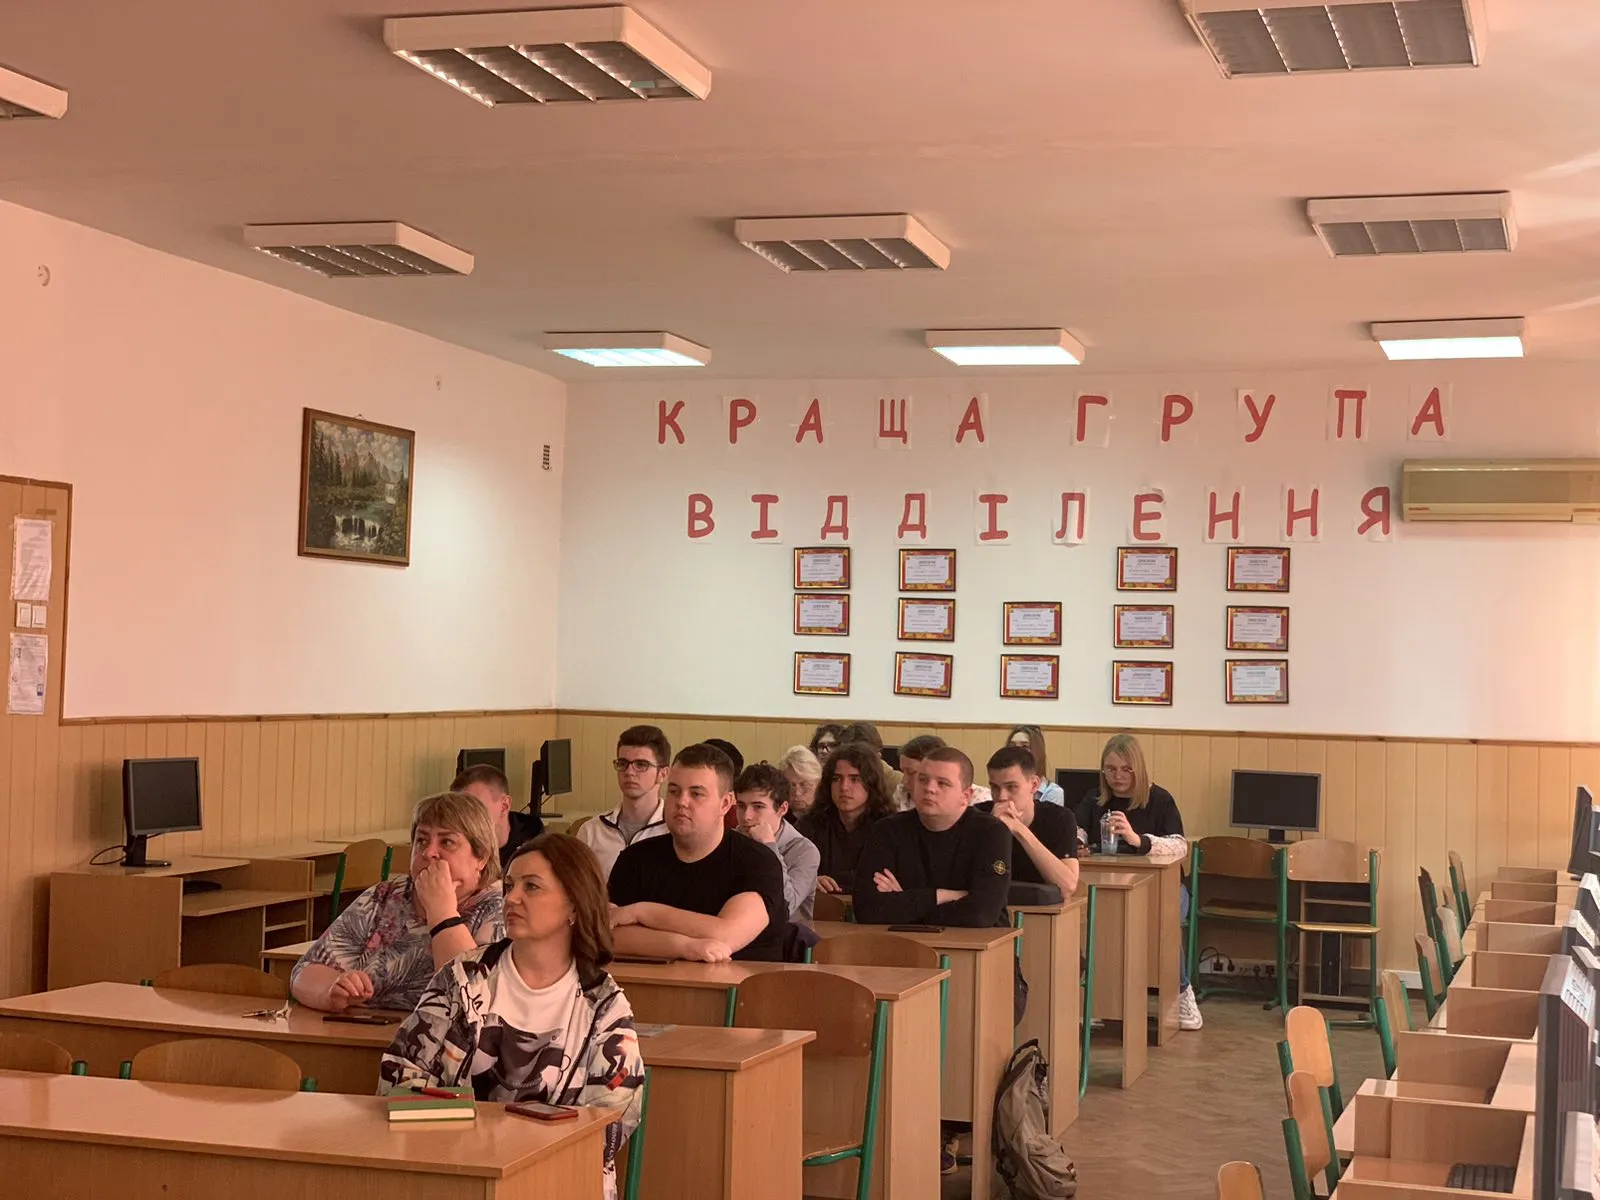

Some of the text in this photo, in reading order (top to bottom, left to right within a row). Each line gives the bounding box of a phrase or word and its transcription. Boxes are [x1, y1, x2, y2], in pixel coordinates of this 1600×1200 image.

[657, 387, 1445, 445] КРАЩА ГРУПА
[687, 486, 1391, 541] ВІДДІЛЕННЯ
